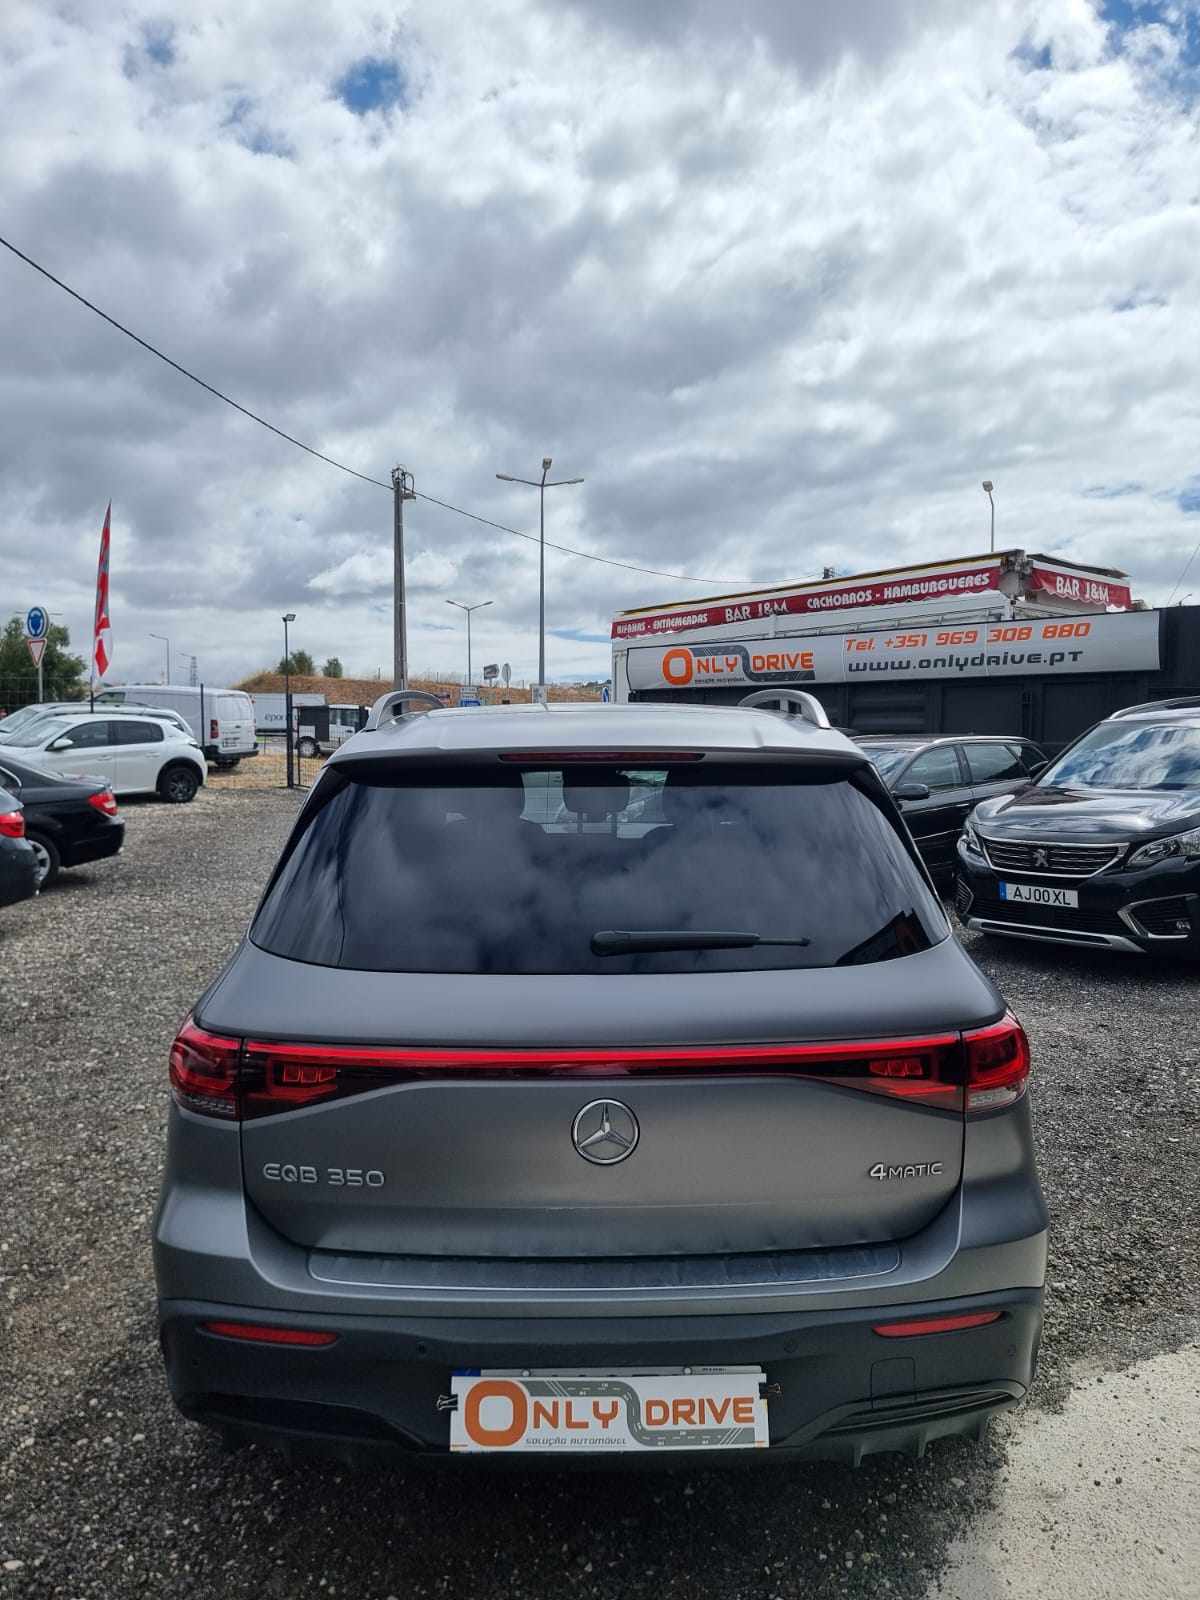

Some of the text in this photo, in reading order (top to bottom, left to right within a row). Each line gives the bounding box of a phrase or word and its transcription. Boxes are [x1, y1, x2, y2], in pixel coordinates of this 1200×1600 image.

[806, 590, 872, 609] CACHORROS
[884, 573, 990, 599] HAMBURGUERES
[1056, 575, 1080, 598] BAR
[725, 605, 751, 622] BAR
[884, 634, 928, 649] +351
[935, 630, 978, 646] 969
[986, 626, 1033, 643] 308
[1042, 622, 1091, 640] 880
[662, 648, 814, 687] ONLY DRIVE
[263, 1163, 385, 1186] EQB 350
[870, 1162, 943, 1181] 4MATIC
[464, 1379, 755, 1447] ONLY DRIVE
